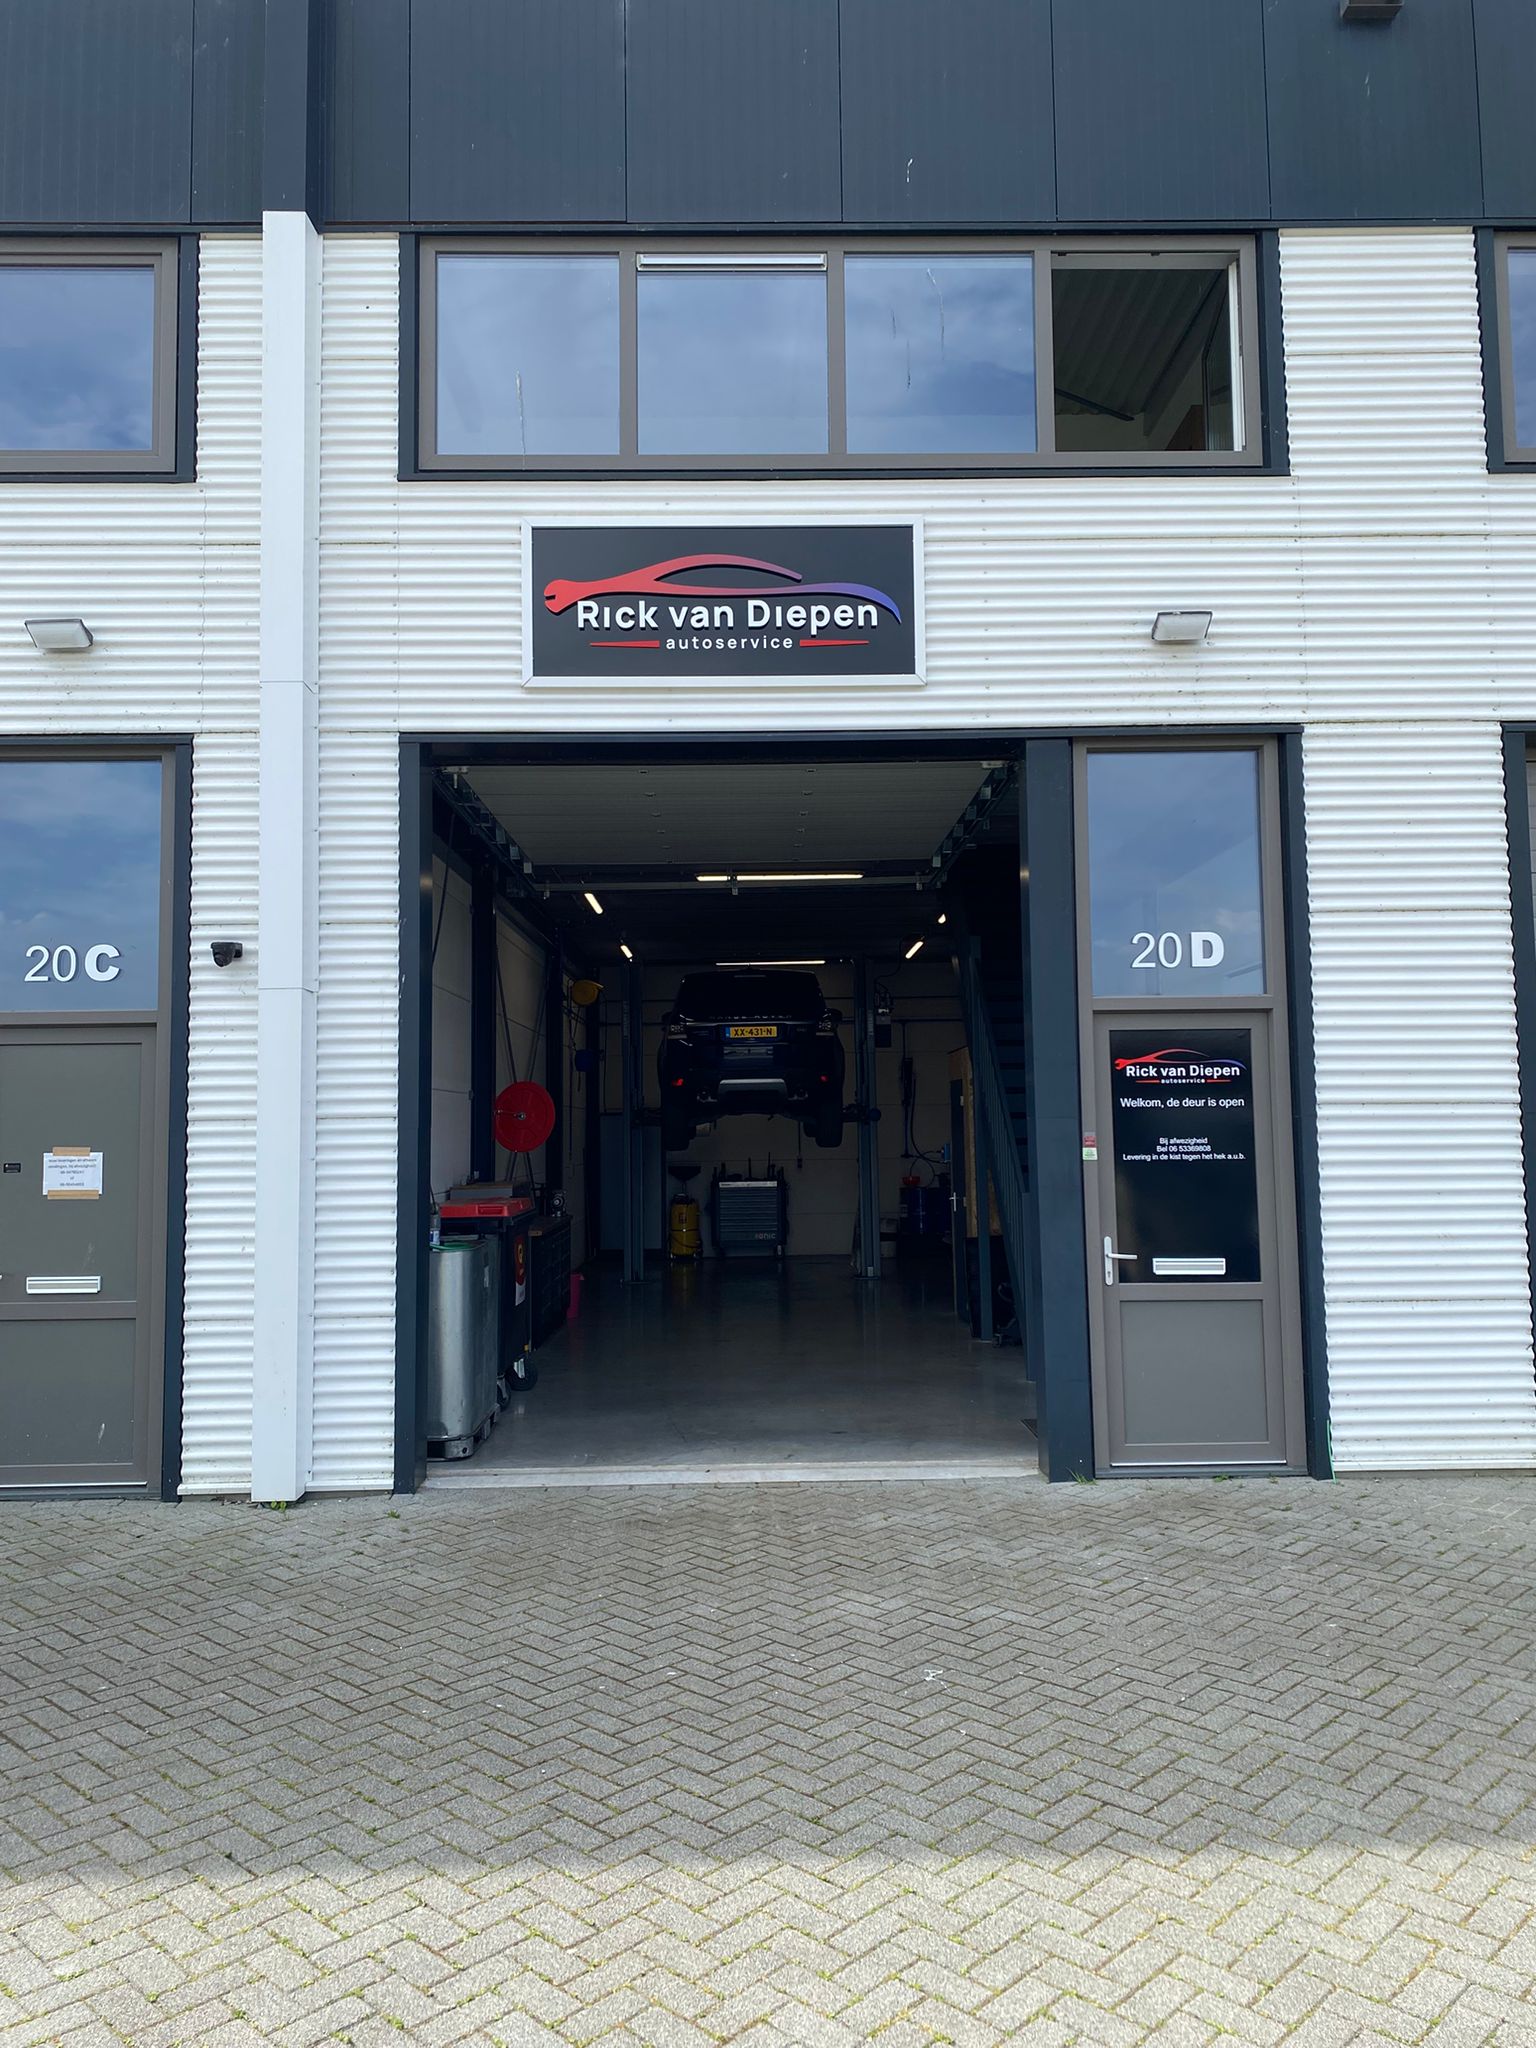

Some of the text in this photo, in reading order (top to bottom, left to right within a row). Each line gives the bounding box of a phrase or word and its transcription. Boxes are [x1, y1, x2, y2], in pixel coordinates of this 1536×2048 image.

[669, 605, 734, 628] van
[665, 635, 793, 650] autoservice
[1131, 931, 1224, 968] 20 D
[24, 944, 120, 982] 20 C
[733, 1027, 773, 1037] XX-431-N
[1126, 1065, 1240, 1079] Rick van Diepen
[1119, 1097, 1245, 1109] Welkom, de deur is open
[1159, 1137, 1209, 1145] Bij afwezigheid
[1122, 1153, 1151, 1162] Levering
[1181, 1153, 1201, 1162] tegen
[1201, 1152, 1213, 1160] het
[1213, 1152, 1226, 1160] hek
[1226, 1152, 1246, 1160] a.u.b.
